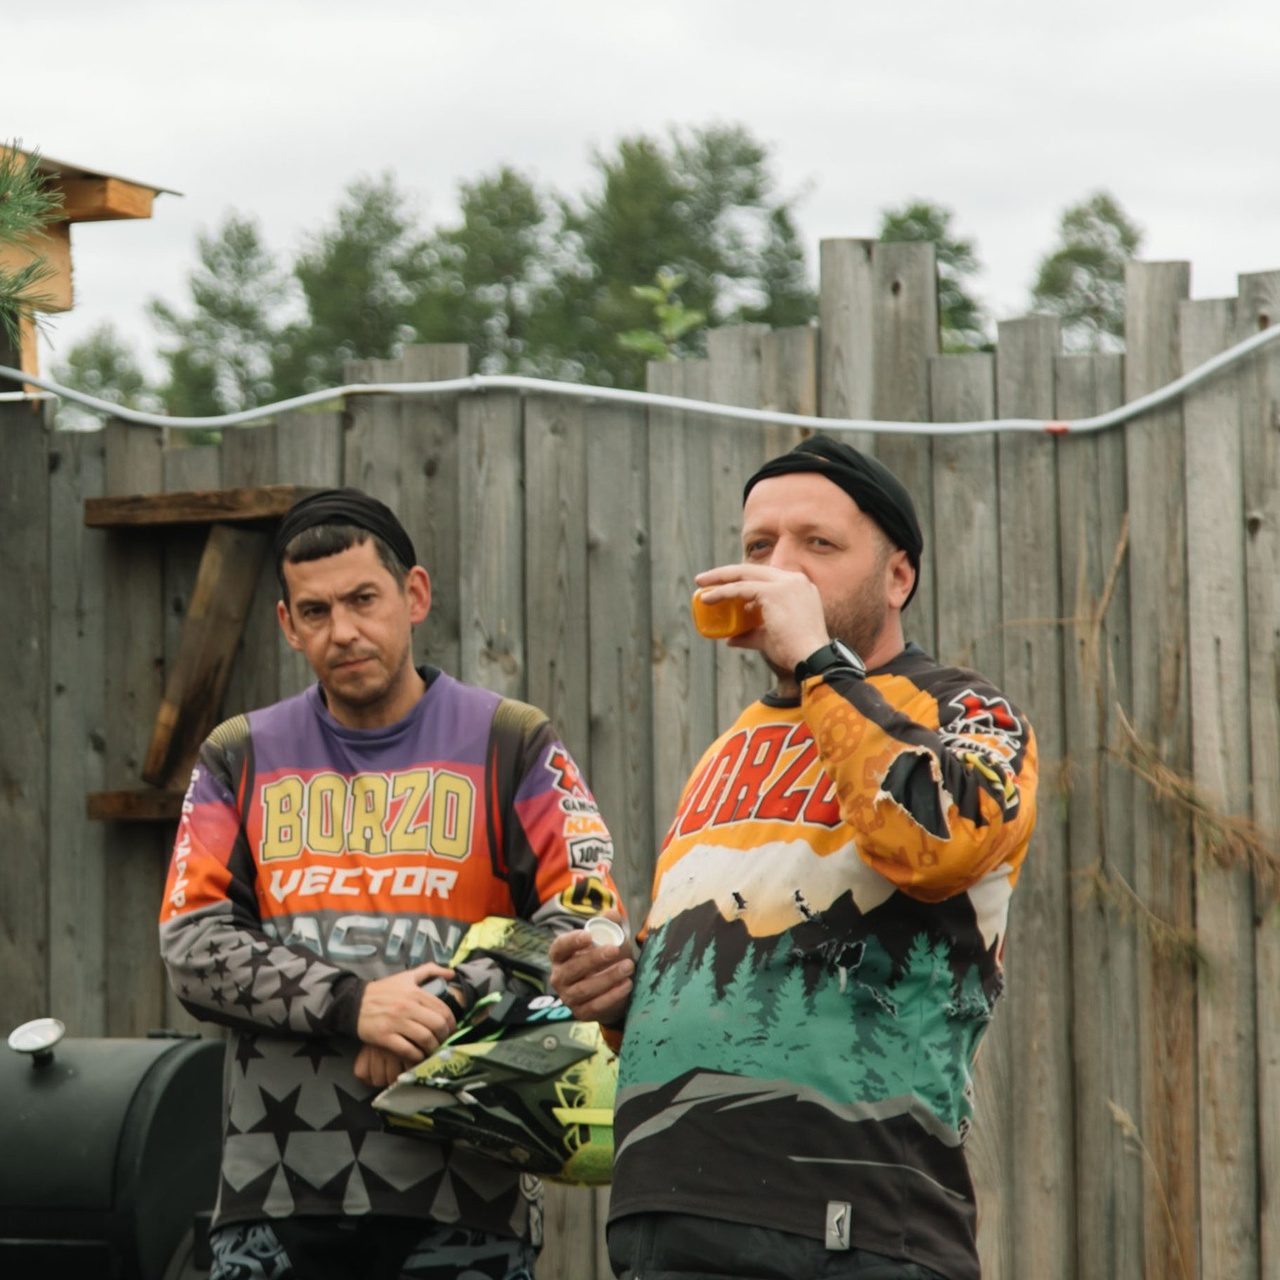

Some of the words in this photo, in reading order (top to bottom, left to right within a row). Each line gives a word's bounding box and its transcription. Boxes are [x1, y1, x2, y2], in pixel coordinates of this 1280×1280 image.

[260, 769, 476, 864] BORZO
[270, 866, 459, 904] VECTOR
[263, 916, 462, 965] ACIN
